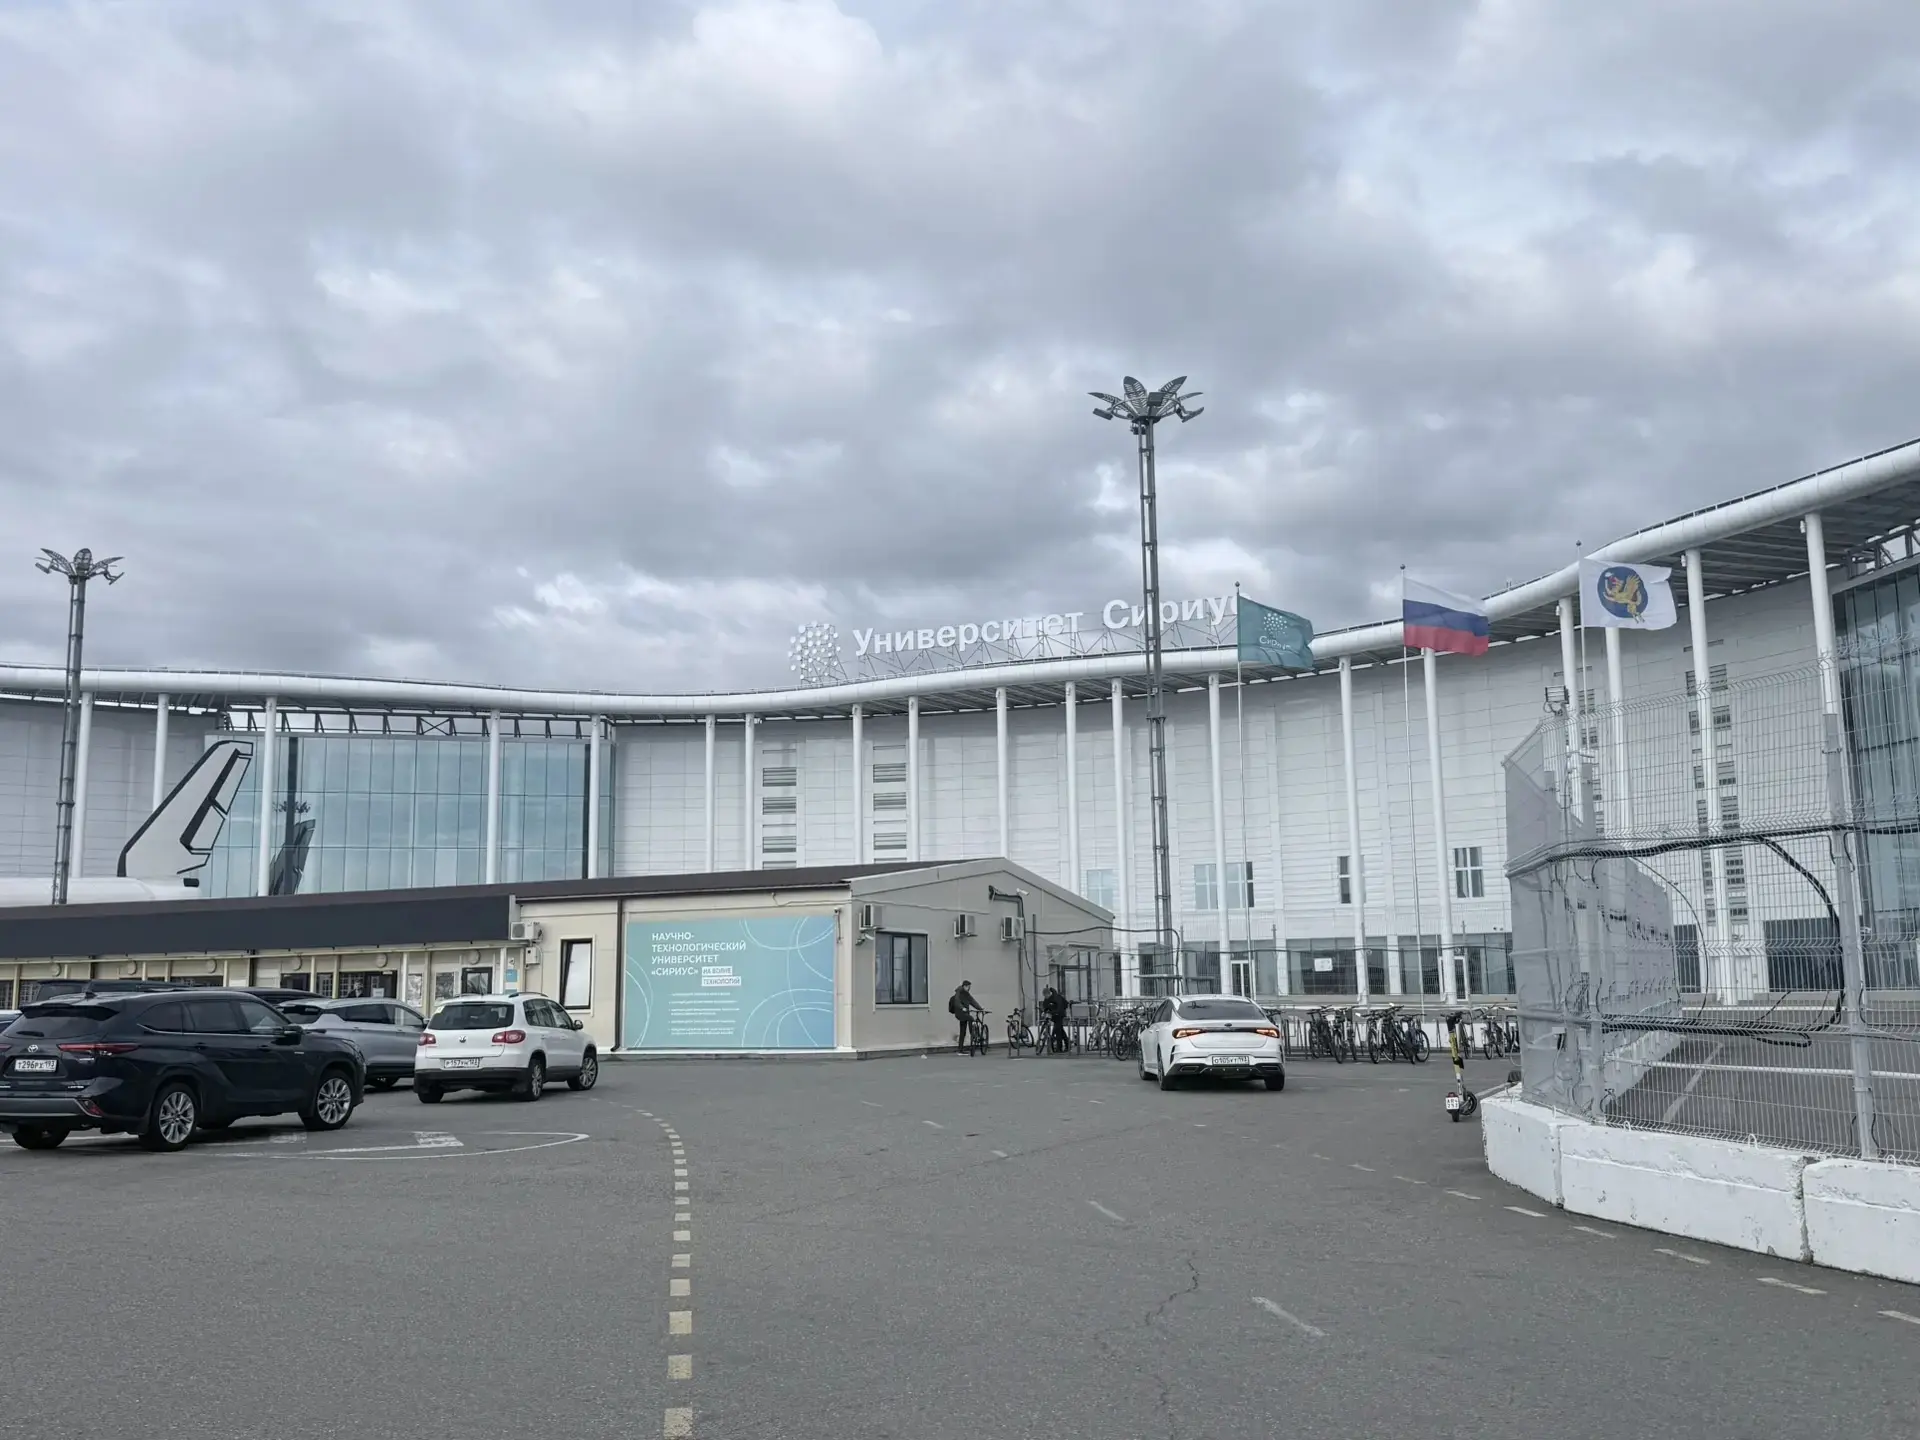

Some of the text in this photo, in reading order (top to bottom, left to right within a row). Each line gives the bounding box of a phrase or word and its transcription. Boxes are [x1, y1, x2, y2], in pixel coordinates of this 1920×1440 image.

[852, 611, 1084, 656] Университет
[651, 931, 695, 941] НАУЧНО-
[651, 940, 747, 953] ТЕХНОЛОГИЧЕСКИЙ
[651, 954, 719, 965] УНИВЕРСИТЕТ
[651, 966, 699, 976] «СИРИУС»
